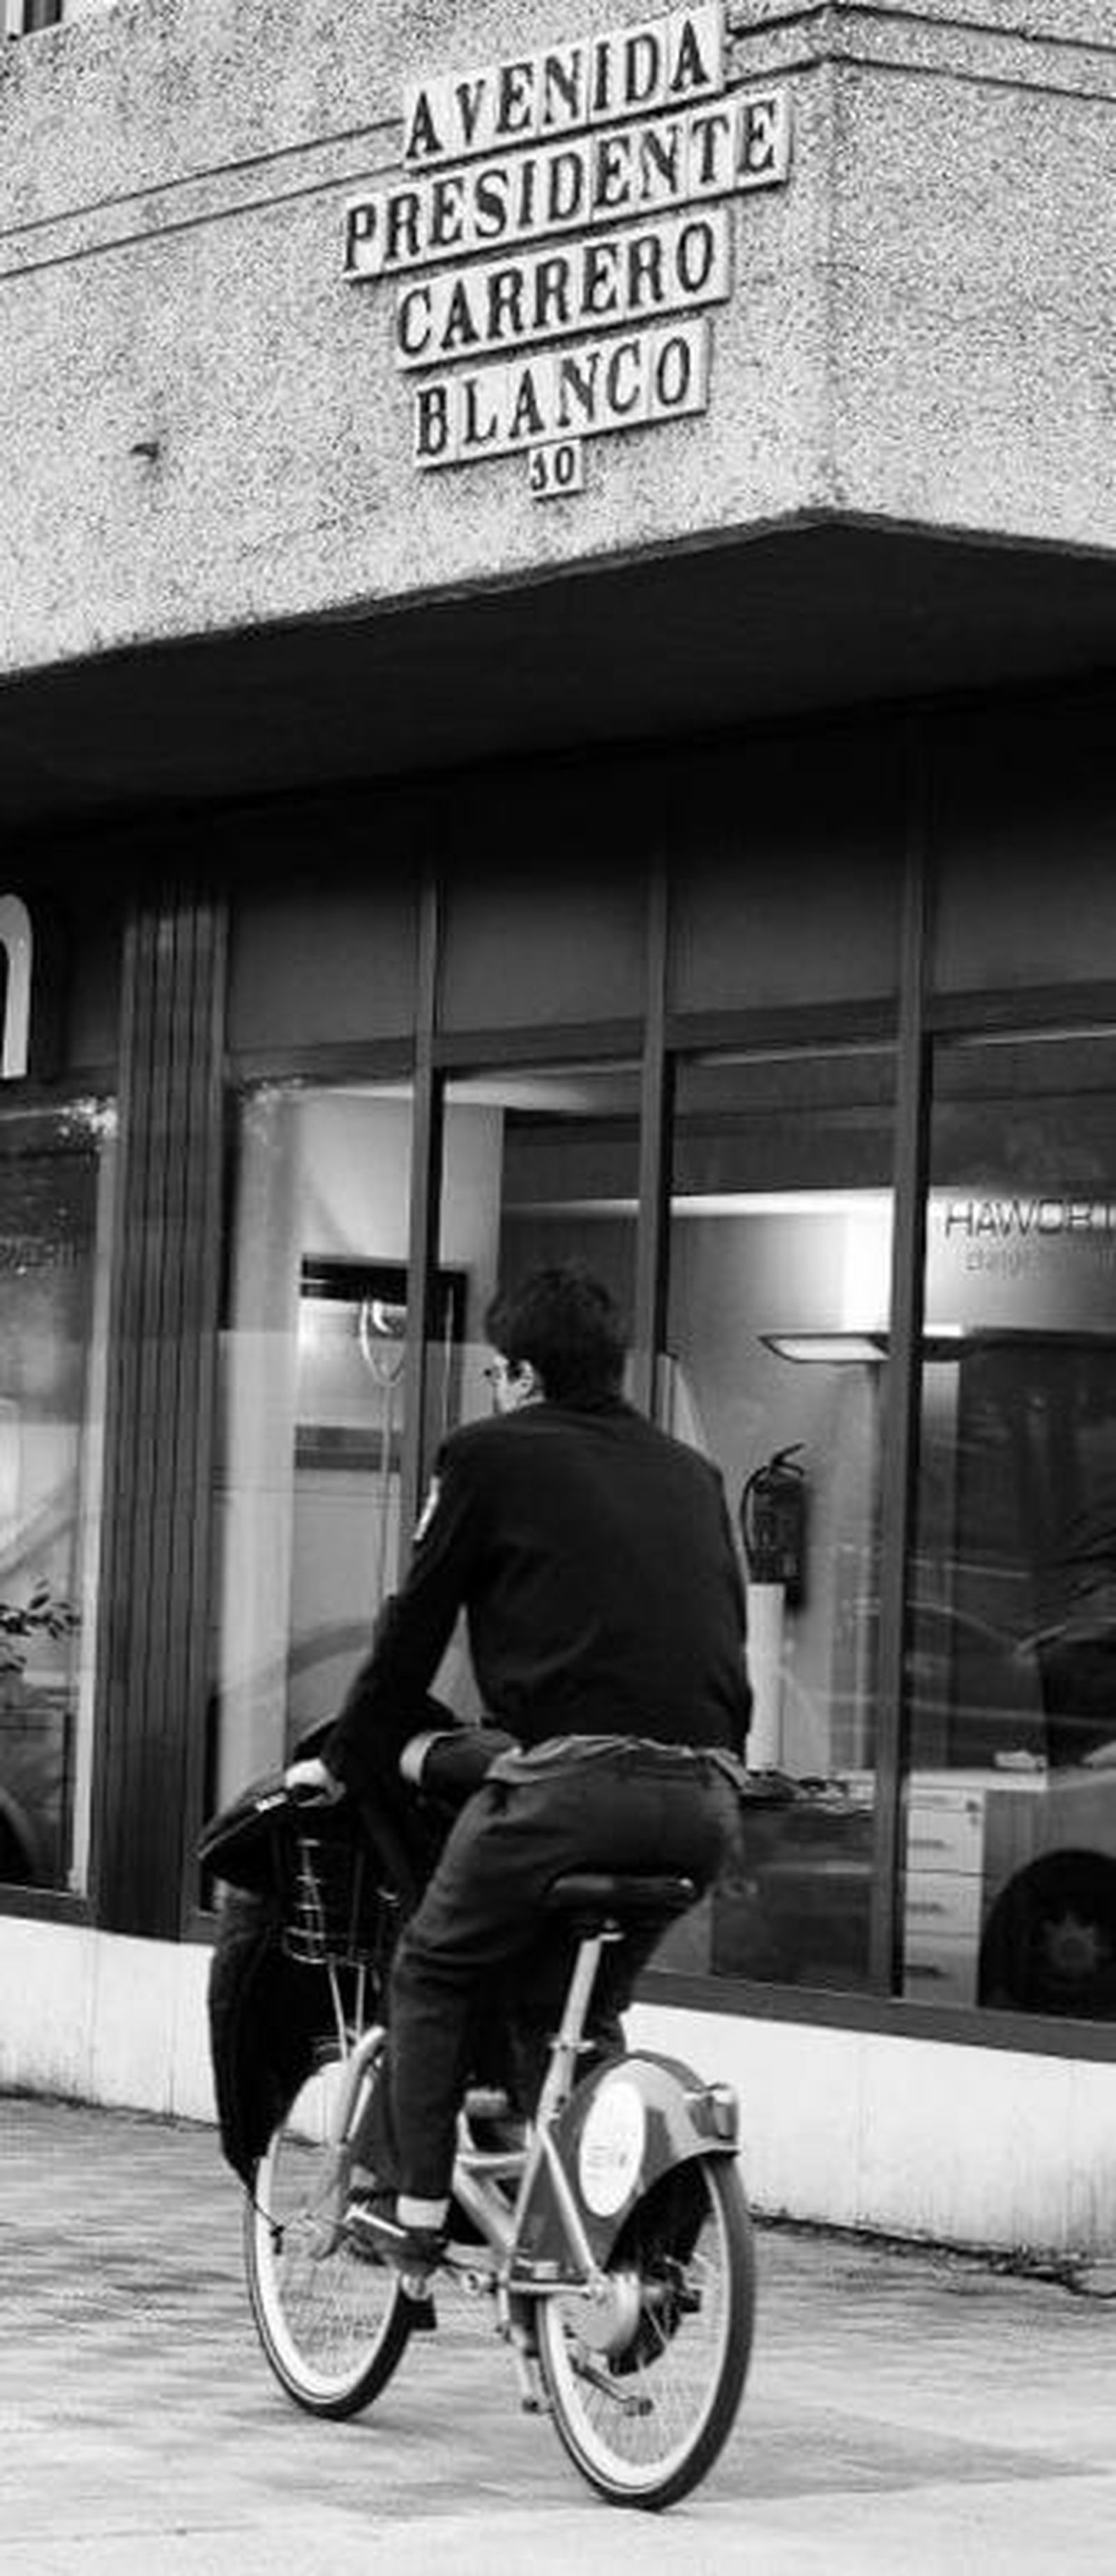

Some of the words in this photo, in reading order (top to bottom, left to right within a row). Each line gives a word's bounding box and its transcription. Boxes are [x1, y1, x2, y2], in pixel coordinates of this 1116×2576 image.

[406, 20, 709, 159] AVENIDA
[343, 101, 777, 272] PRESIDENTE
[398, 222, 714, 356] CARRERO
[417, 337, 691, 456] BLANCO
